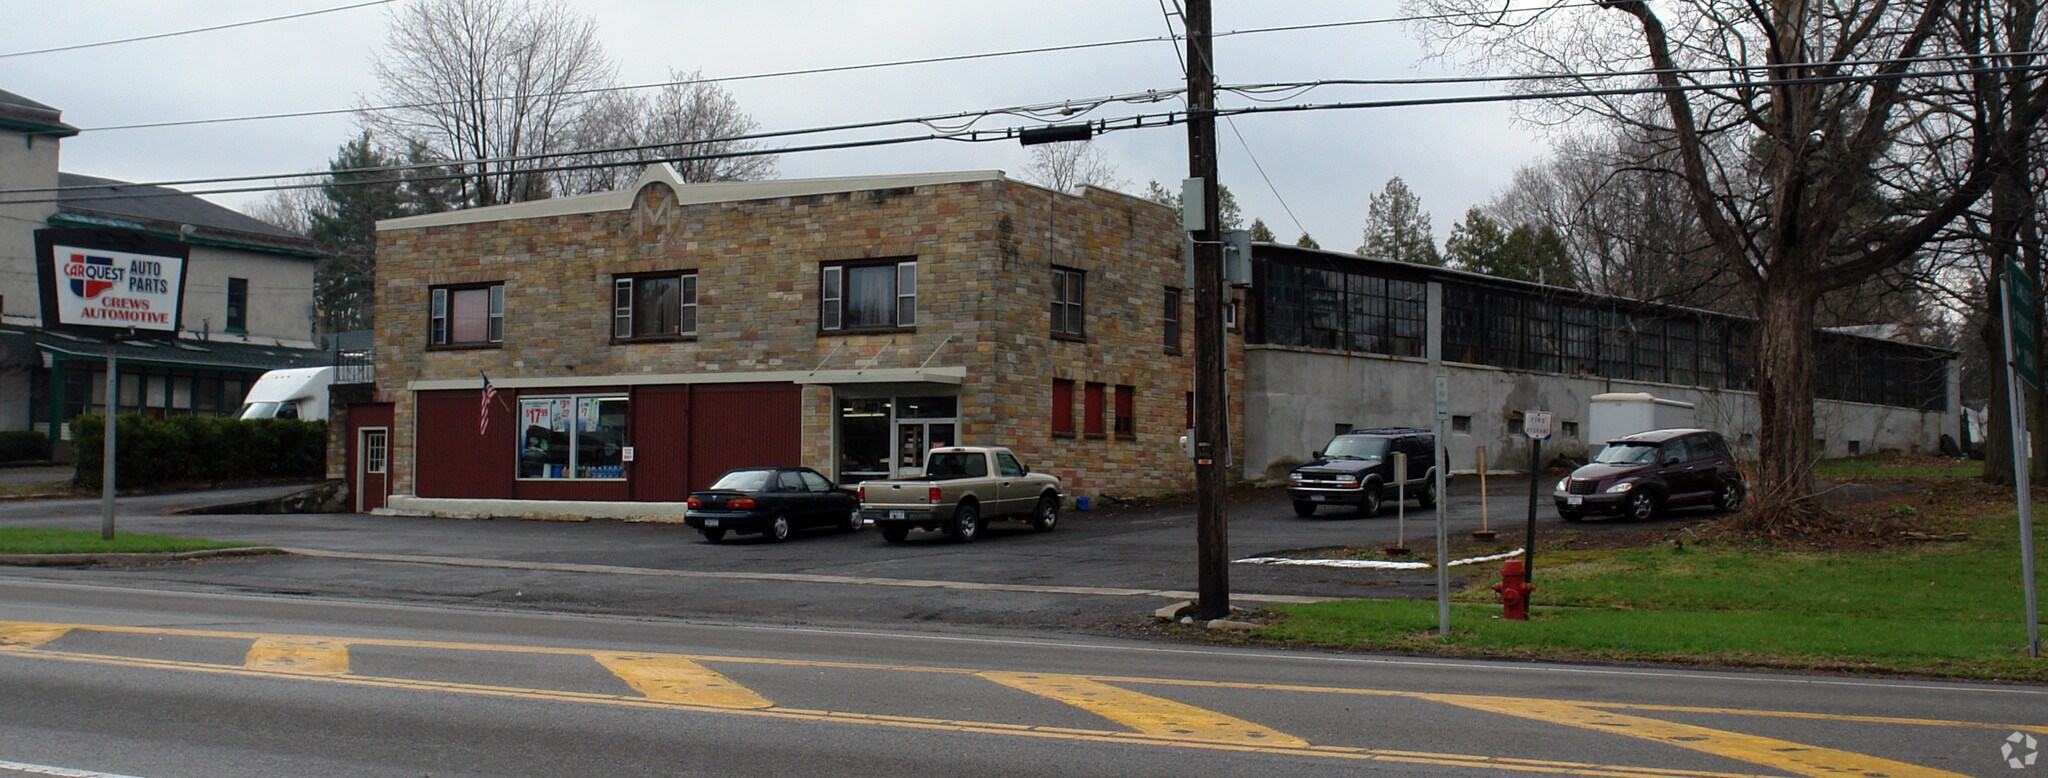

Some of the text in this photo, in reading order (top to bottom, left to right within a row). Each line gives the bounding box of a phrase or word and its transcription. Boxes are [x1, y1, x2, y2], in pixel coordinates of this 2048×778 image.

[638, 192, 672, 236] M
[64, 263, 125, 281] CARQUEST
[130, 260, 161, 276] AUTO
[129, 277, 168, 294] PARTS
[102, 296, 150, 310] CREWS
[81, 308, 169, 324] AUTOMOTIVE
[1530, 416, 1545, 424] FIRE
